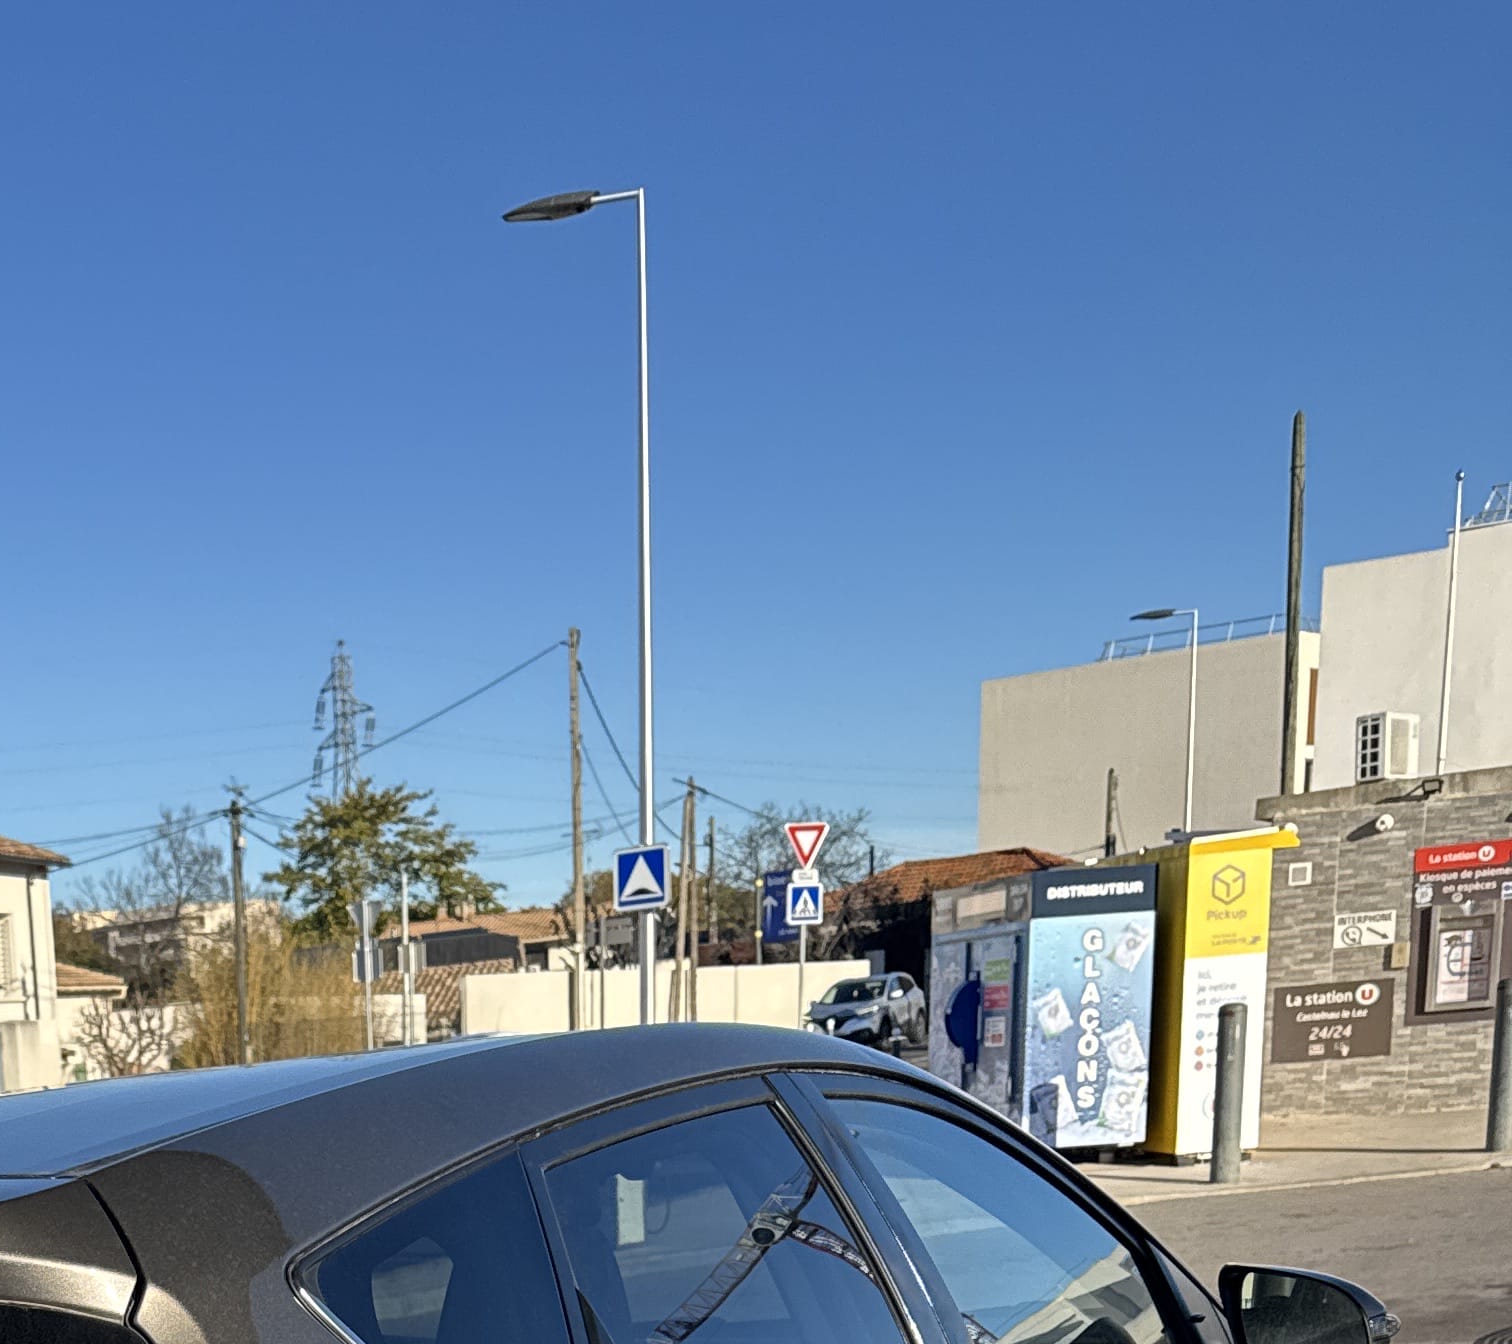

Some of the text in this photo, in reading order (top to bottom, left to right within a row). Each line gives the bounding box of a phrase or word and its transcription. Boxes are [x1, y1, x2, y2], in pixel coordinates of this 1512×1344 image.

[1428, 853, 1441, 865] La
[1442, 850, 1477, 863] station
[1419, 871, 1458, 883] Kiosque
[1460, 868, 1473, 880] de
[1046, 880, 1144, 900] DISTRIBUTEUR
[1442, 884, 1456, 894] en
[1206, 909, 1248, 922] Pickup
[1338, 912, 1393, 926] INTERPHONE
[1286, 993, 1303, 1008] La
[1304, 990, 1353, 1006] station
[1076, 928, 1104, 1109] GLAÇONS
[1308, 1023, 1353, 1041] 24/24
